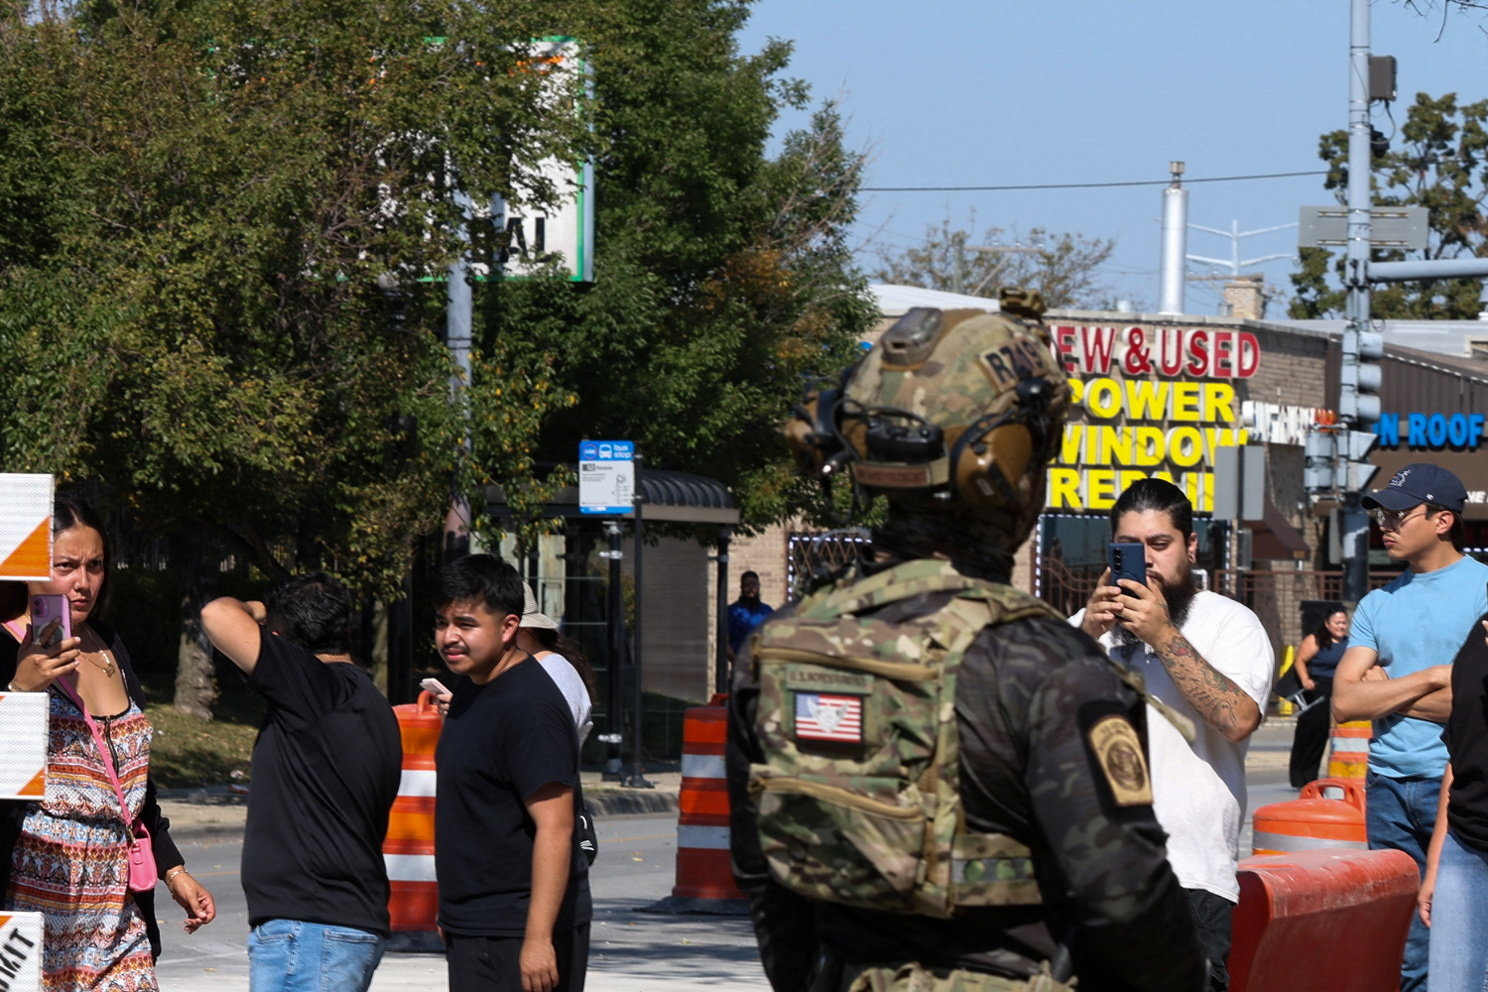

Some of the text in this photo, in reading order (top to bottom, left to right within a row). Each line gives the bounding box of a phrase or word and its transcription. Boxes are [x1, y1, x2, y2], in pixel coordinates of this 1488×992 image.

[1050, 326, 1115, 374] EW
[1161, 328, 1261, 378] USED
[1408, 412, 1484, 448] ROOF
